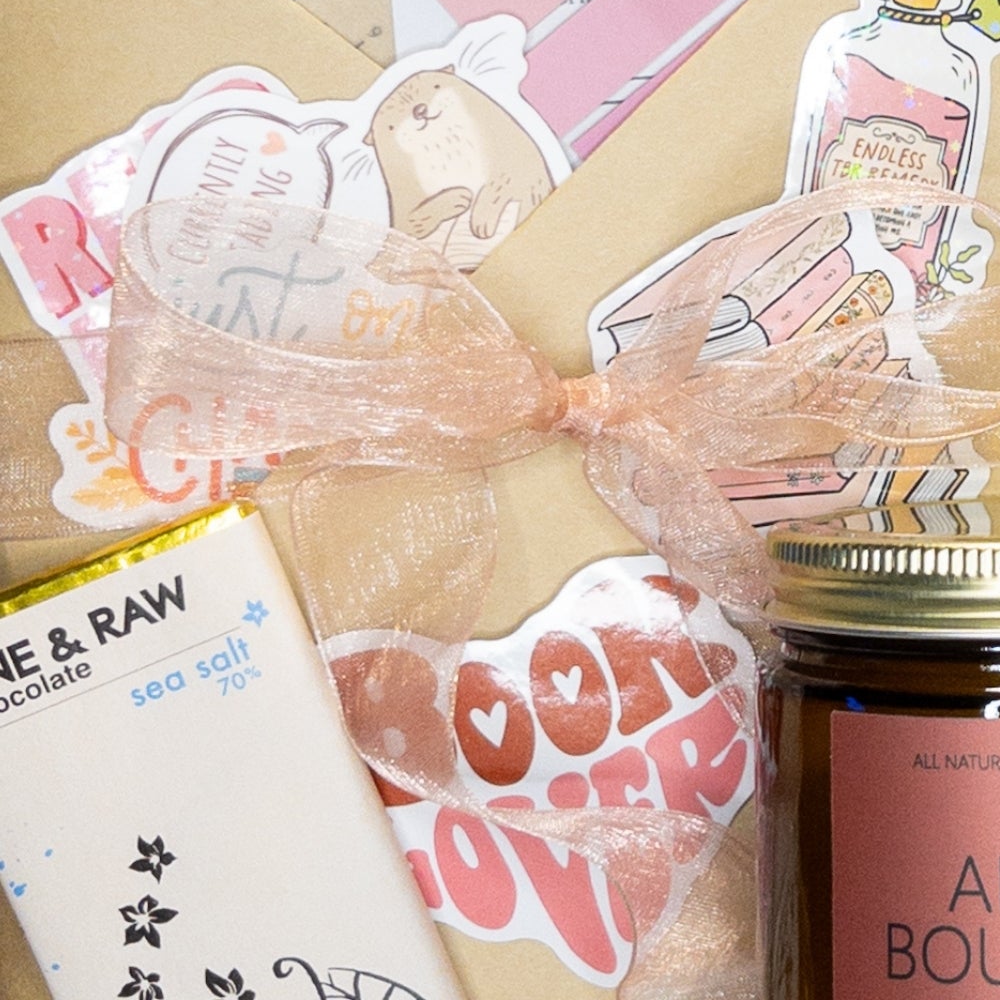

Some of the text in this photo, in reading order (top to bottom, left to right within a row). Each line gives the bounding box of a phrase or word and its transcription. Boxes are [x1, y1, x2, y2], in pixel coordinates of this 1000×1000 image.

[852, 137, 927, 171] ENDLESS
[47, 627, 90, 663] &
[87, 574, 186, 646] RAW
[130, 636, 251, 707] sea salt
[217, 664, 262, 697] 70%
[912, 752, 940, 770] ALL
